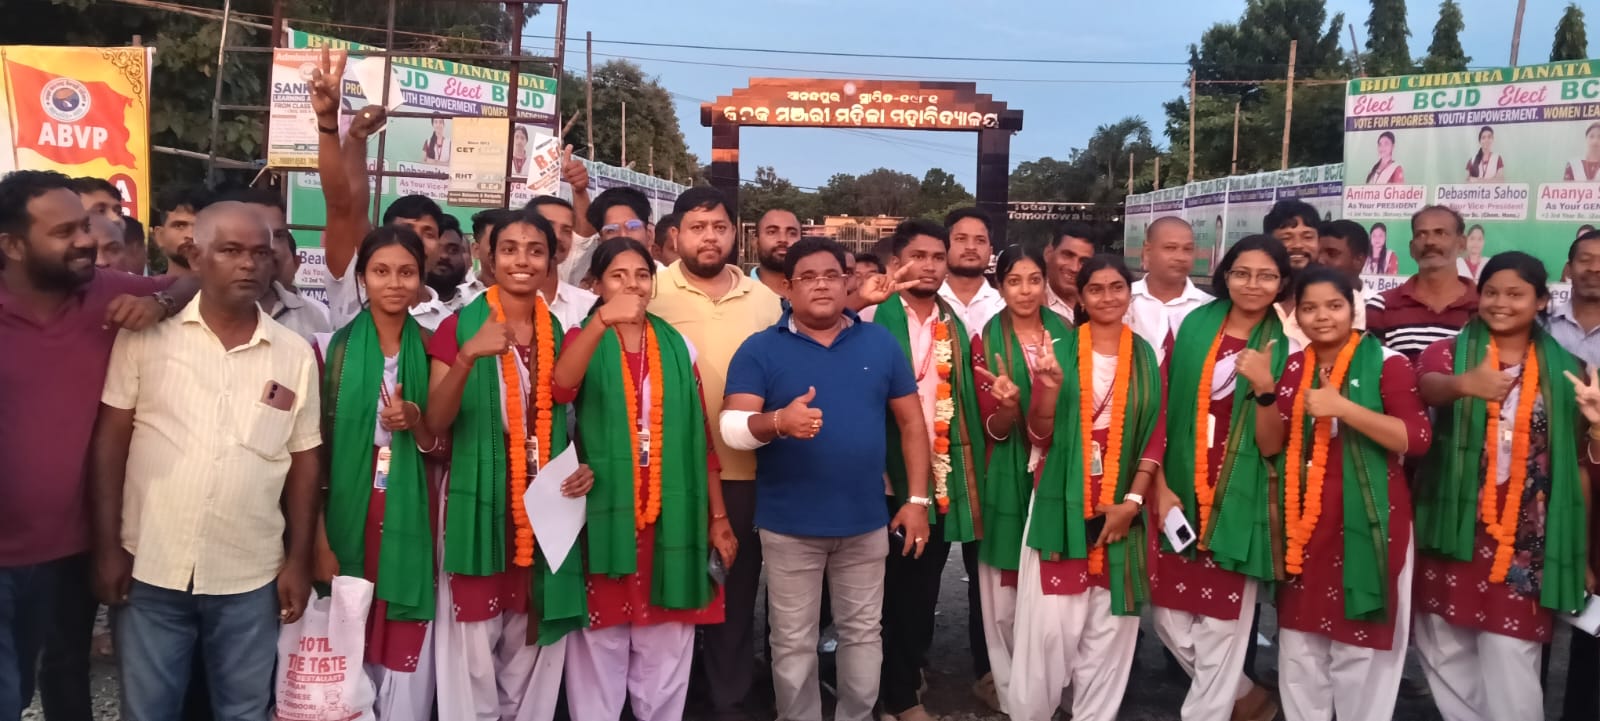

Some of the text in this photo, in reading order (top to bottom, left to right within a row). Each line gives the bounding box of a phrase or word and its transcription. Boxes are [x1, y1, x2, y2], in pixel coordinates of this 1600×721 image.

[452, 62, 510, 83] JANATA
[1360, 62, 1592, 92] BIJU CHHATRA JANATA
[400, 70, 544, 109] JD Elect BJD
[1353, 95, 1394, 115] Elect
[1413, 88, 1481, 110] BCJD
[1498, 84, 1547, 107] Elect
[420, 94, 478, 114] EMPOWERMENT.
[1354, 116, 1374, 129] VOTE
[1374, 115, 1390, 128] FOR
[1391, 113, 1437, 128] PROGRESS.
[1438, 111, 1466, 125] YOUTH
[1467, 107, 1539, 123] EMPOWERMENT.
[1543, 105, 1581, 119] WOMEN
[37, 121, 108, 150] ABVP
[1346, 186, 1424, 200] Anima Ghadei
[1438, 185, 1527, 200] Debasmita Sahoo
[1541, 185, 1593, 203] Ananya
[1008, 210, 1069, 219] Tomorrow
[1545, 202, 1557, 210] As
[1560, 202, 1581, 210] Your
